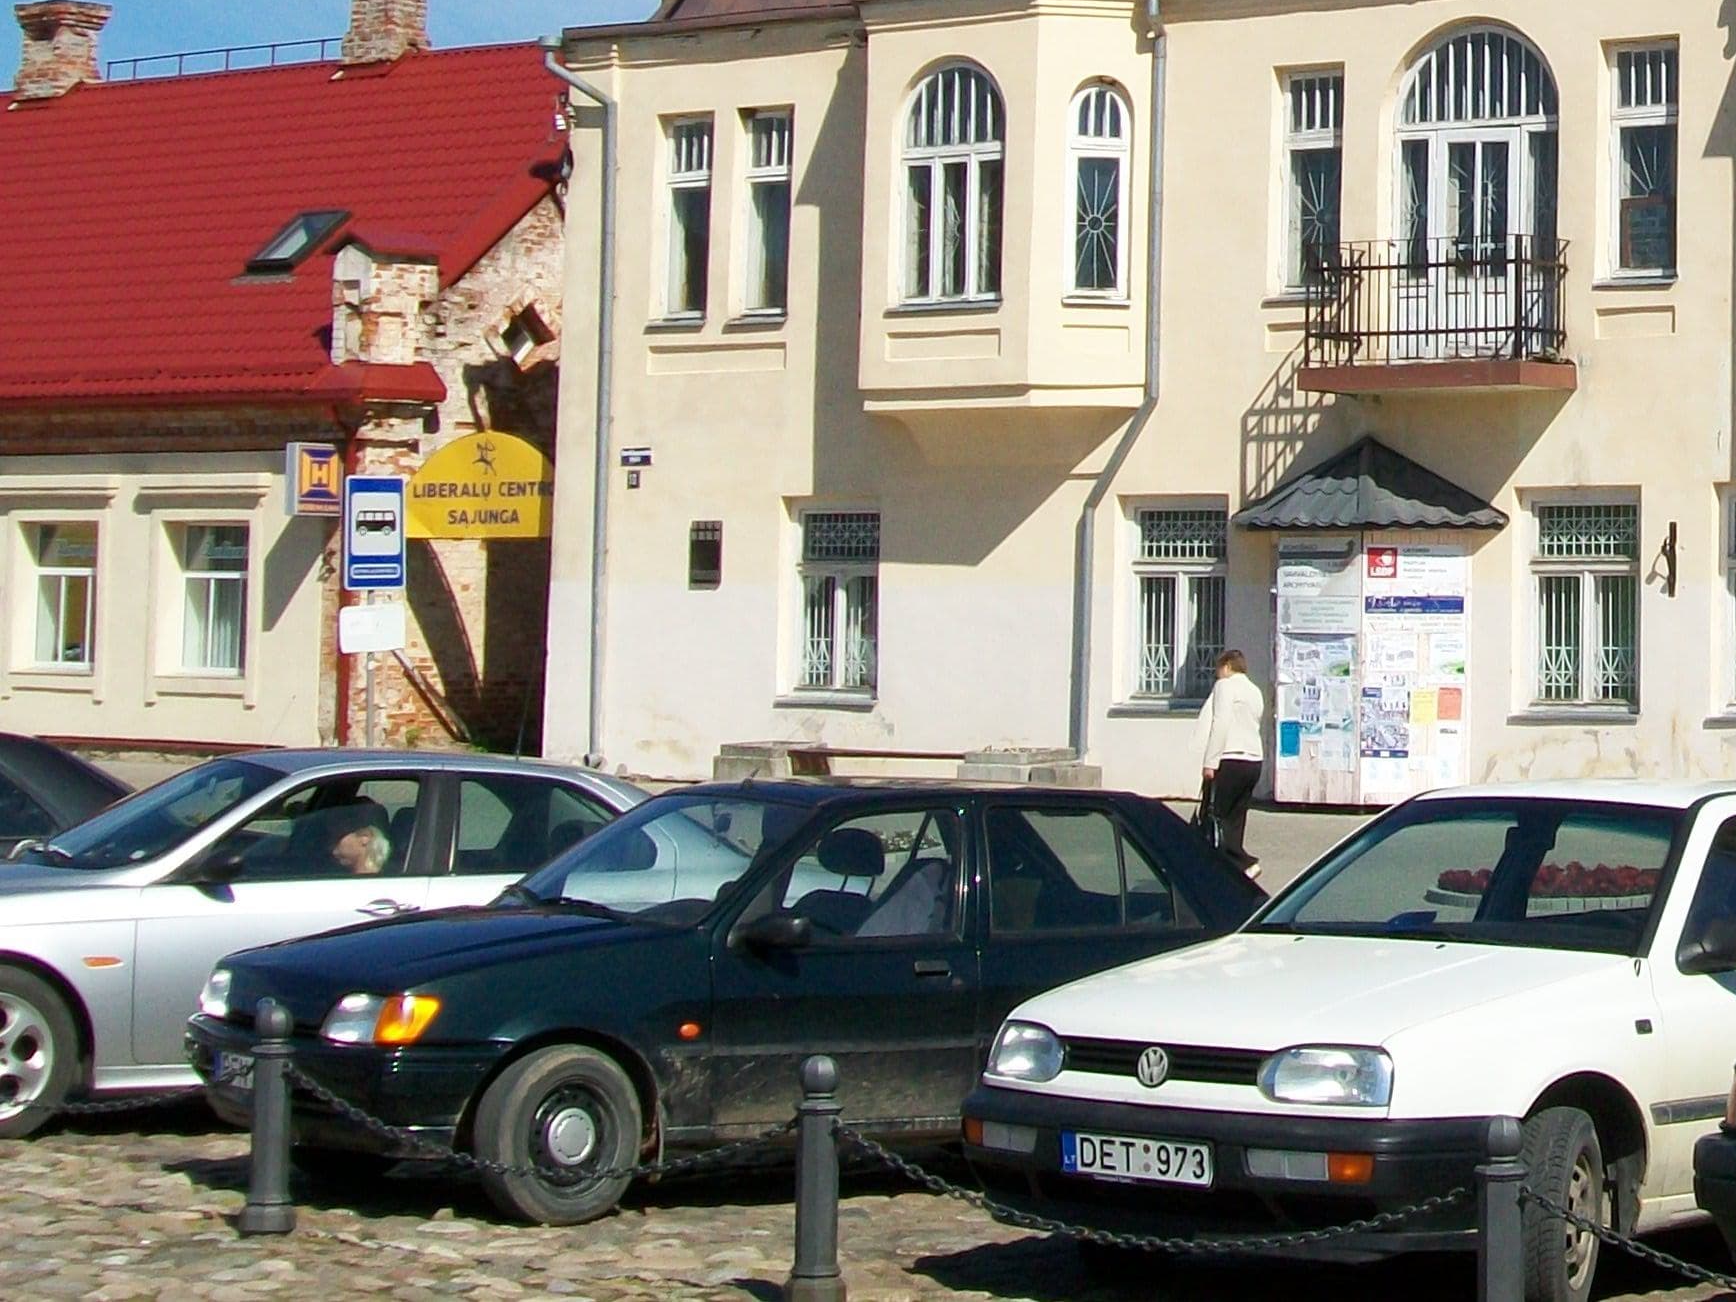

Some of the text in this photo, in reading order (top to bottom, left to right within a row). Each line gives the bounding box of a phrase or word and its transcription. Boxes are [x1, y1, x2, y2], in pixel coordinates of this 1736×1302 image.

[413, 482, 491, 501] LIBERALŲ
[448, 509, 519, 528] SĄJUNGA
[1079, 1136, 1205, 1179] DET 973
